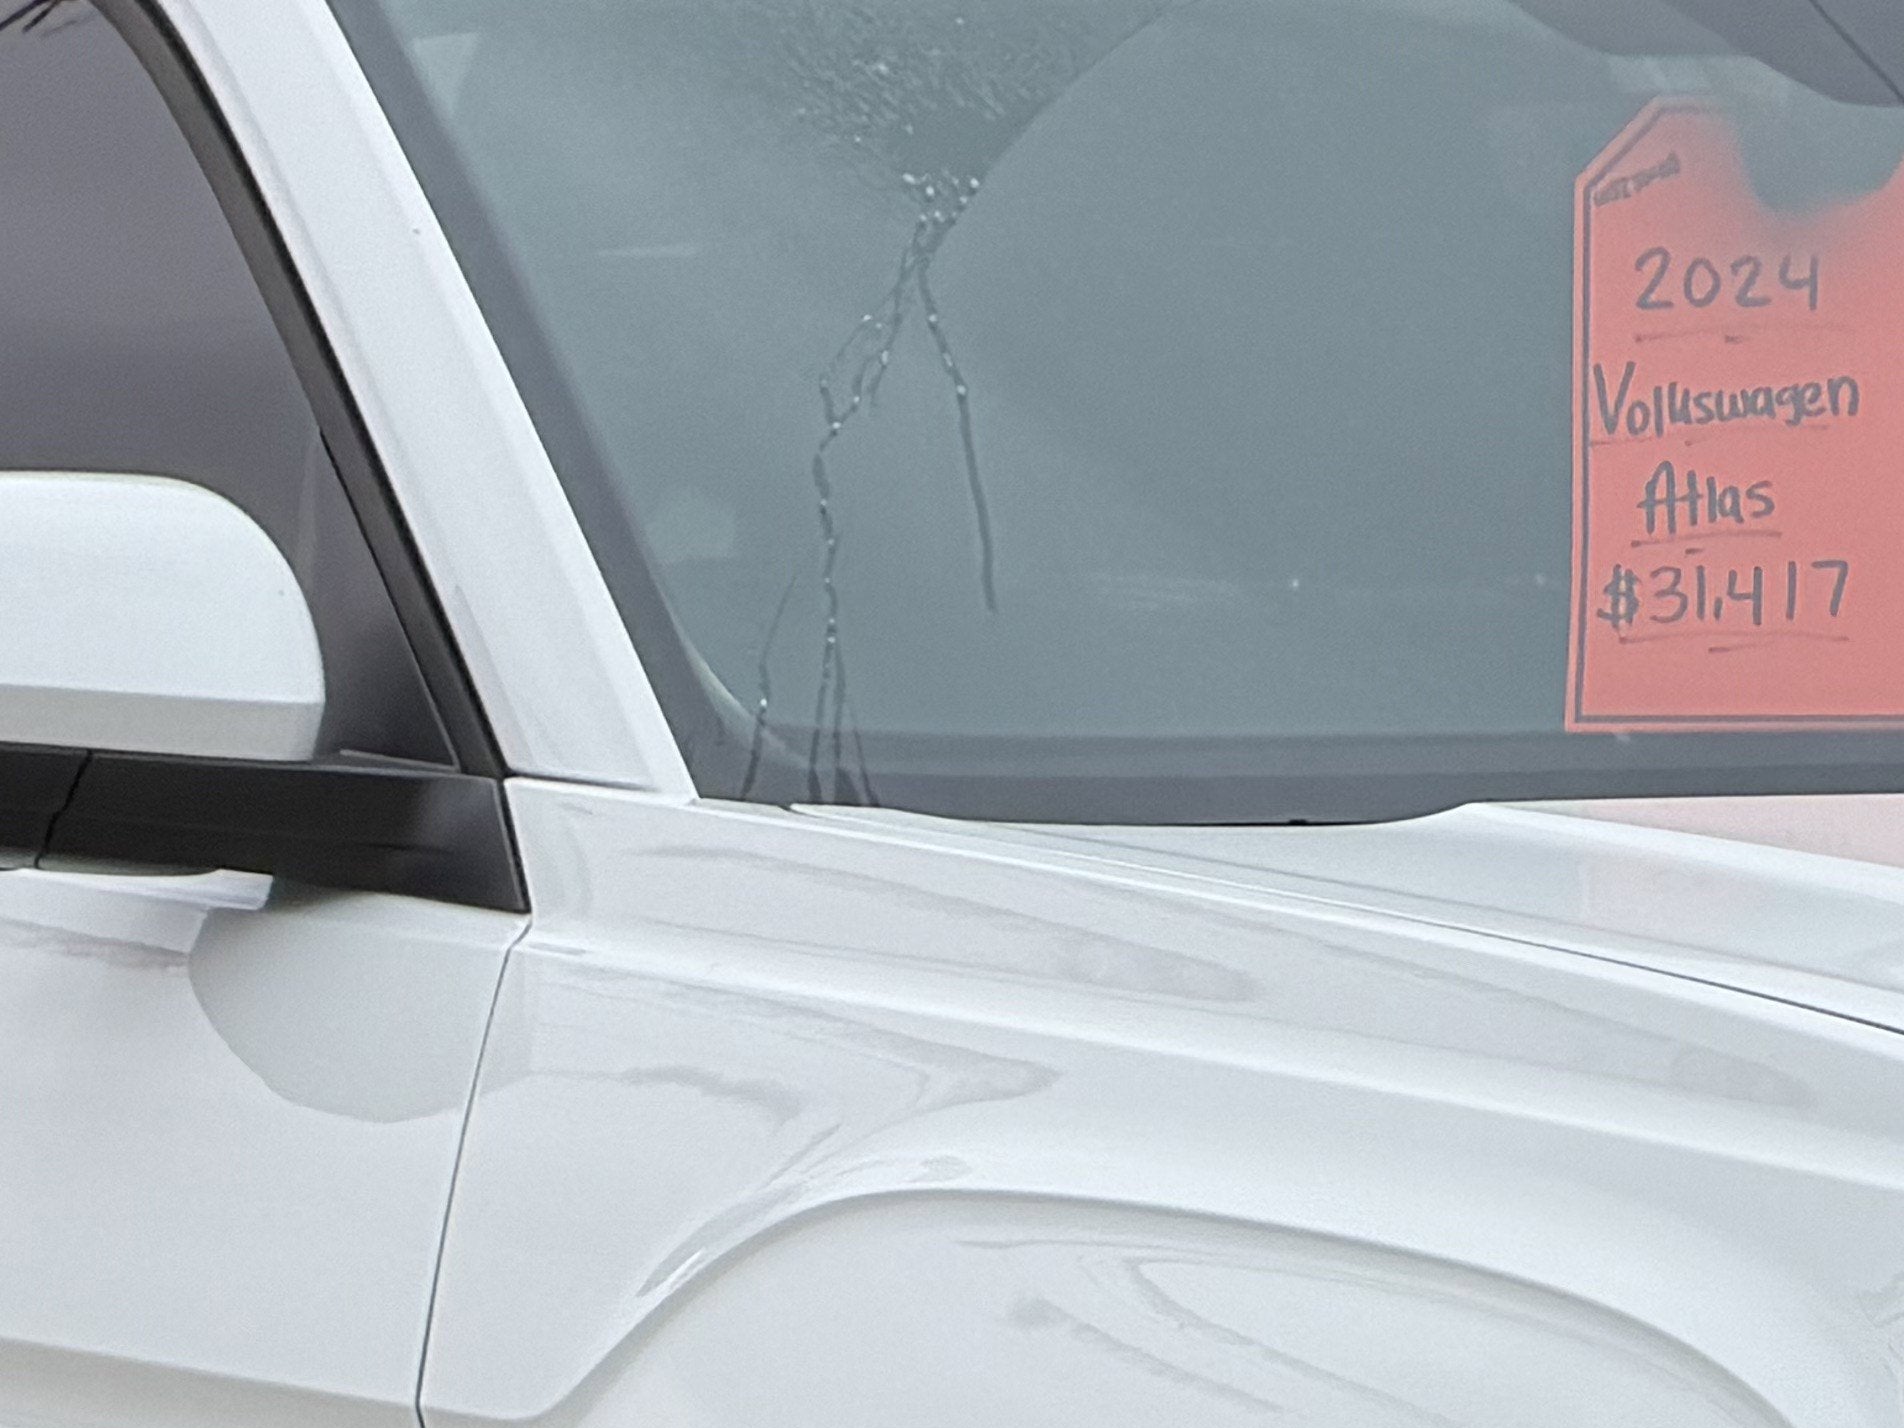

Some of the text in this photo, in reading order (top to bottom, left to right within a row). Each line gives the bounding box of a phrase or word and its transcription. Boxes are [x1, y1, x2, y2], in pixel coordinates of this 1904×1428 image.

[1635, 246, 1820, 312] 2024
[1636, 460, 1776, 535] Atlas
[1597, 560, 1850, 630] $31,417
